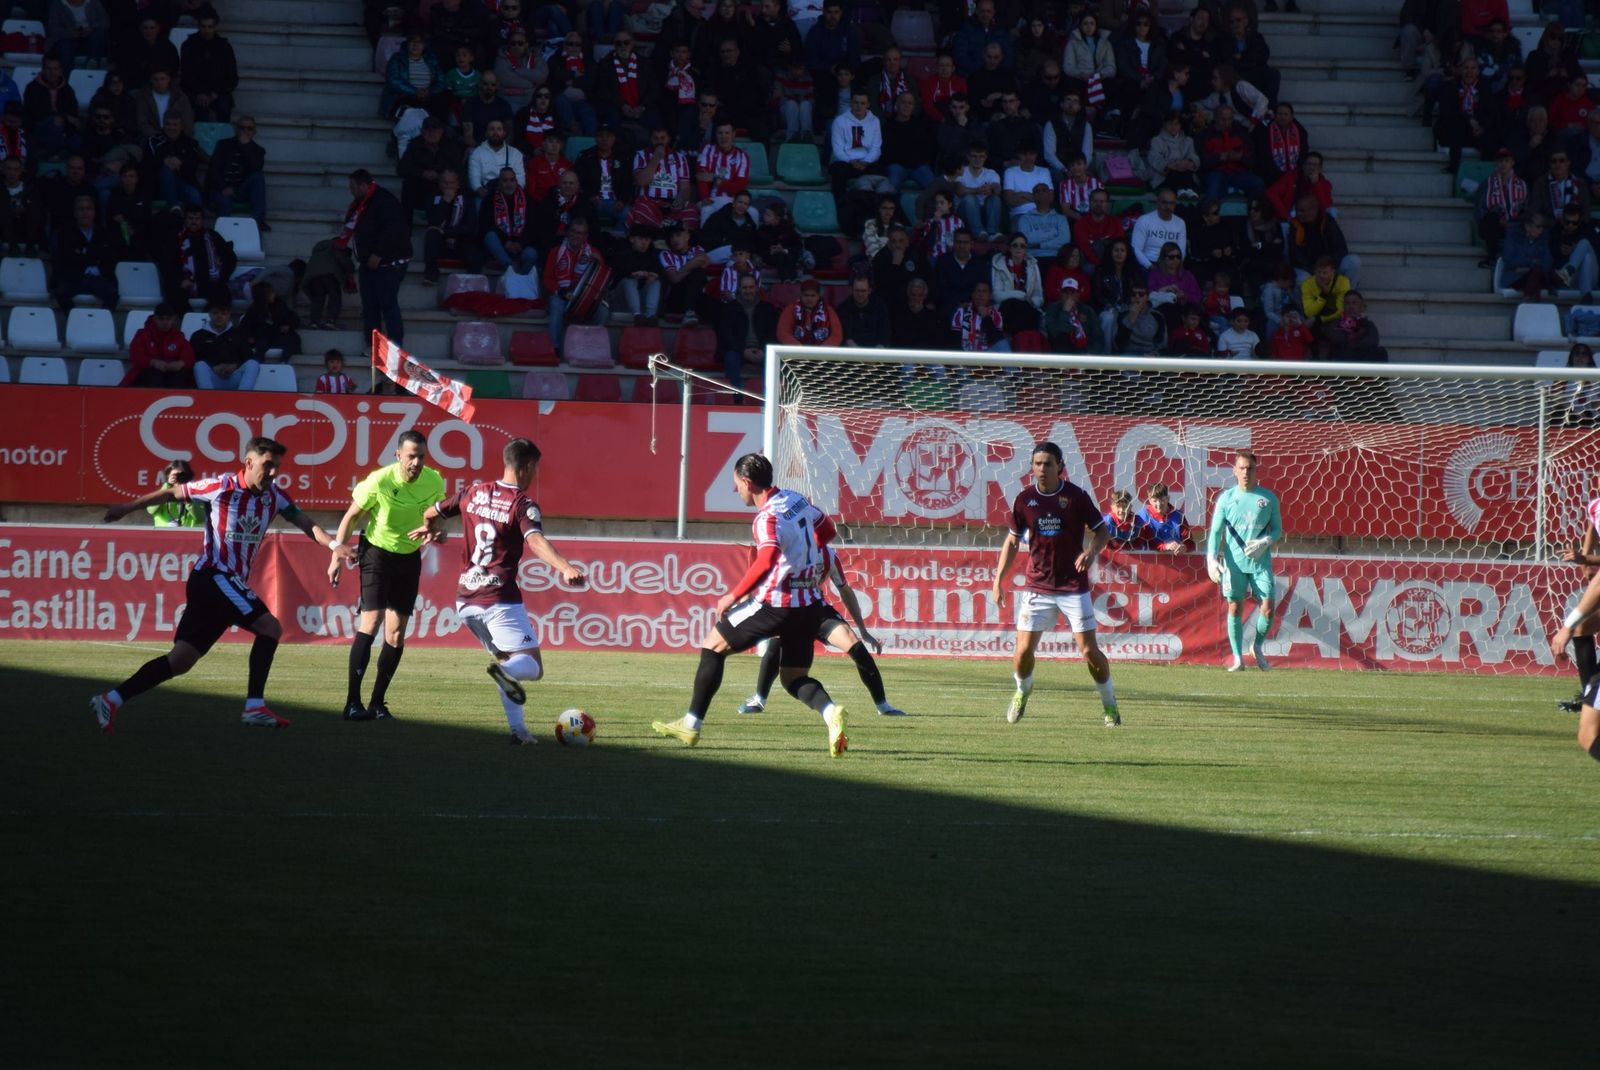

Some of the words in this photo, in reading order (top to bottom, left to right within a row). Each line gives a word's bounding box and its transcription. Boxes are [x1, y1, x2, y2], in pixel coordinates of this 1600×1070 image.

[471, 522, 496, 567] 8
[798, 517, 812, 565] 7
[516, 553, 728, 596] scuela
[829, 570, 1170, 627] Sumier
[125, 602, 147, 642] y
